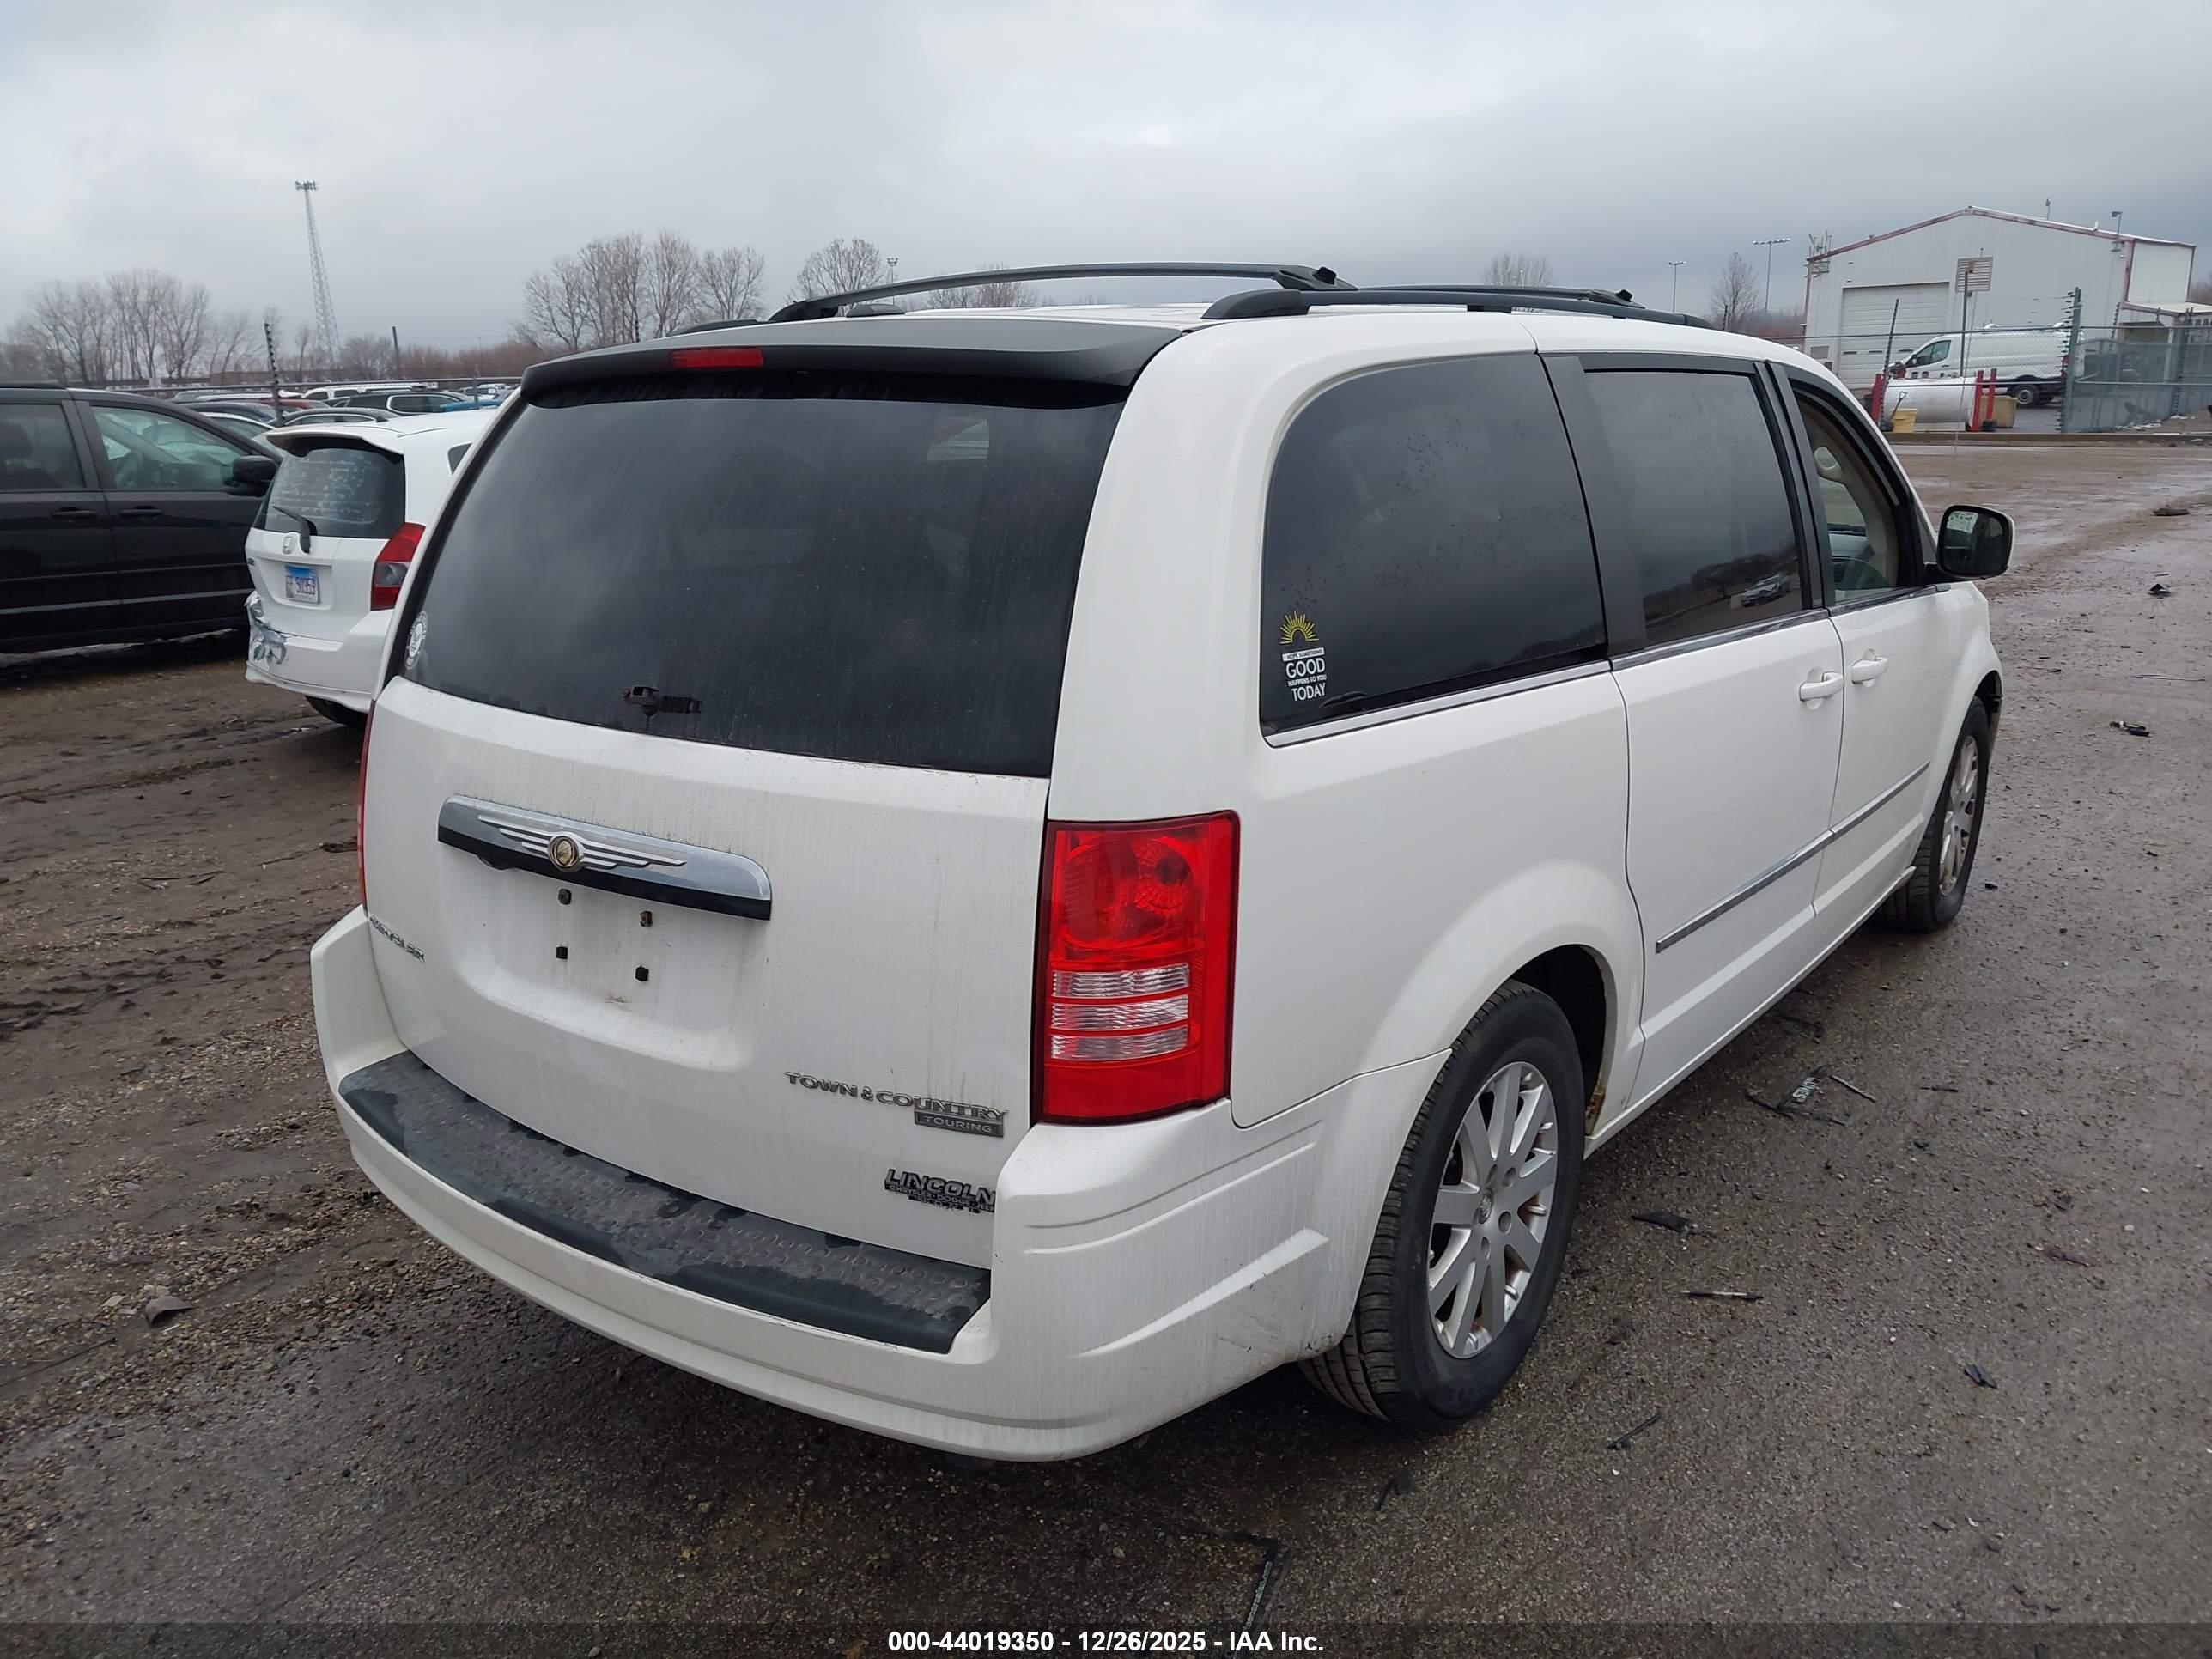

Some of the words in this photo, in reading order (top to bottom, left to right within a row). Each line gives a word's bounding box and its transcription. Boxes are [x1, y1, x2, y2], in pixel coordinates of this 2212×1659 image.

[1286, 658, 1325, 678] GOOD
[1288, 678, 1310, 687] HAPPENS
[1291, 683, 1326, 701] TODAY
[785, 1072, 858, 1098] TOWN
[861, 1086, 874, 1102] &
[876, 1091, 1009, 1121] COUNTRY
[925, 1115, 993, 1133] TOURING
[884, 1169, 996, 1206] LINCOLN
